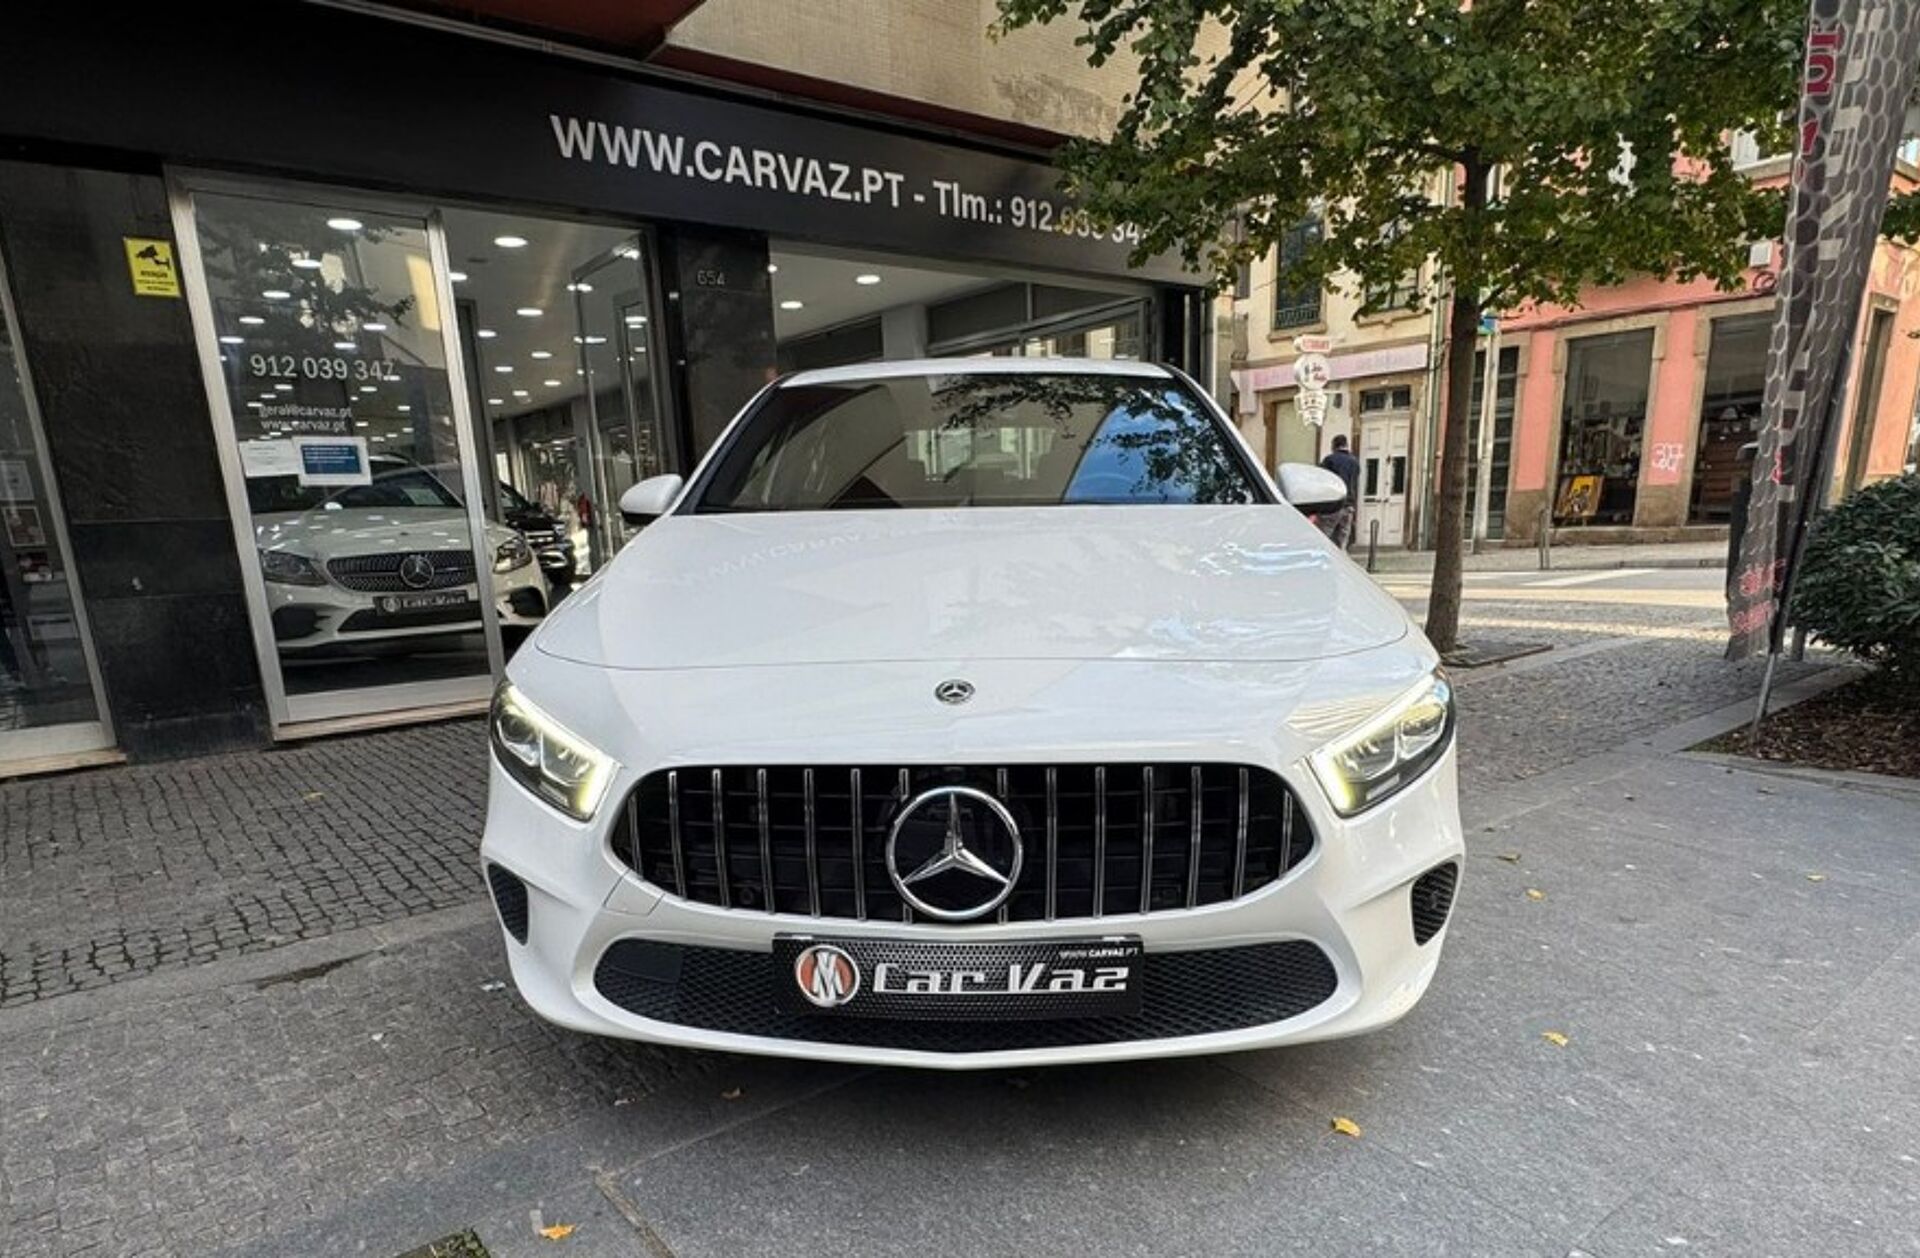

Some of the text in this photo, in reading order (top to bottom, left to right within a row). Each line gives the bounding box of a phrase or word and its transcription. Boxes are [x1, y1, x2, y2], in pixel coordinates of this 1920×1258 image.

[549, 114, 904, 208] WWW.CARVAZ.PT
[932, 180, 1003, 224] Tlm.:
[250, 353, 396, 381] 912 039 347
[872, 963, 986, 994] Car
